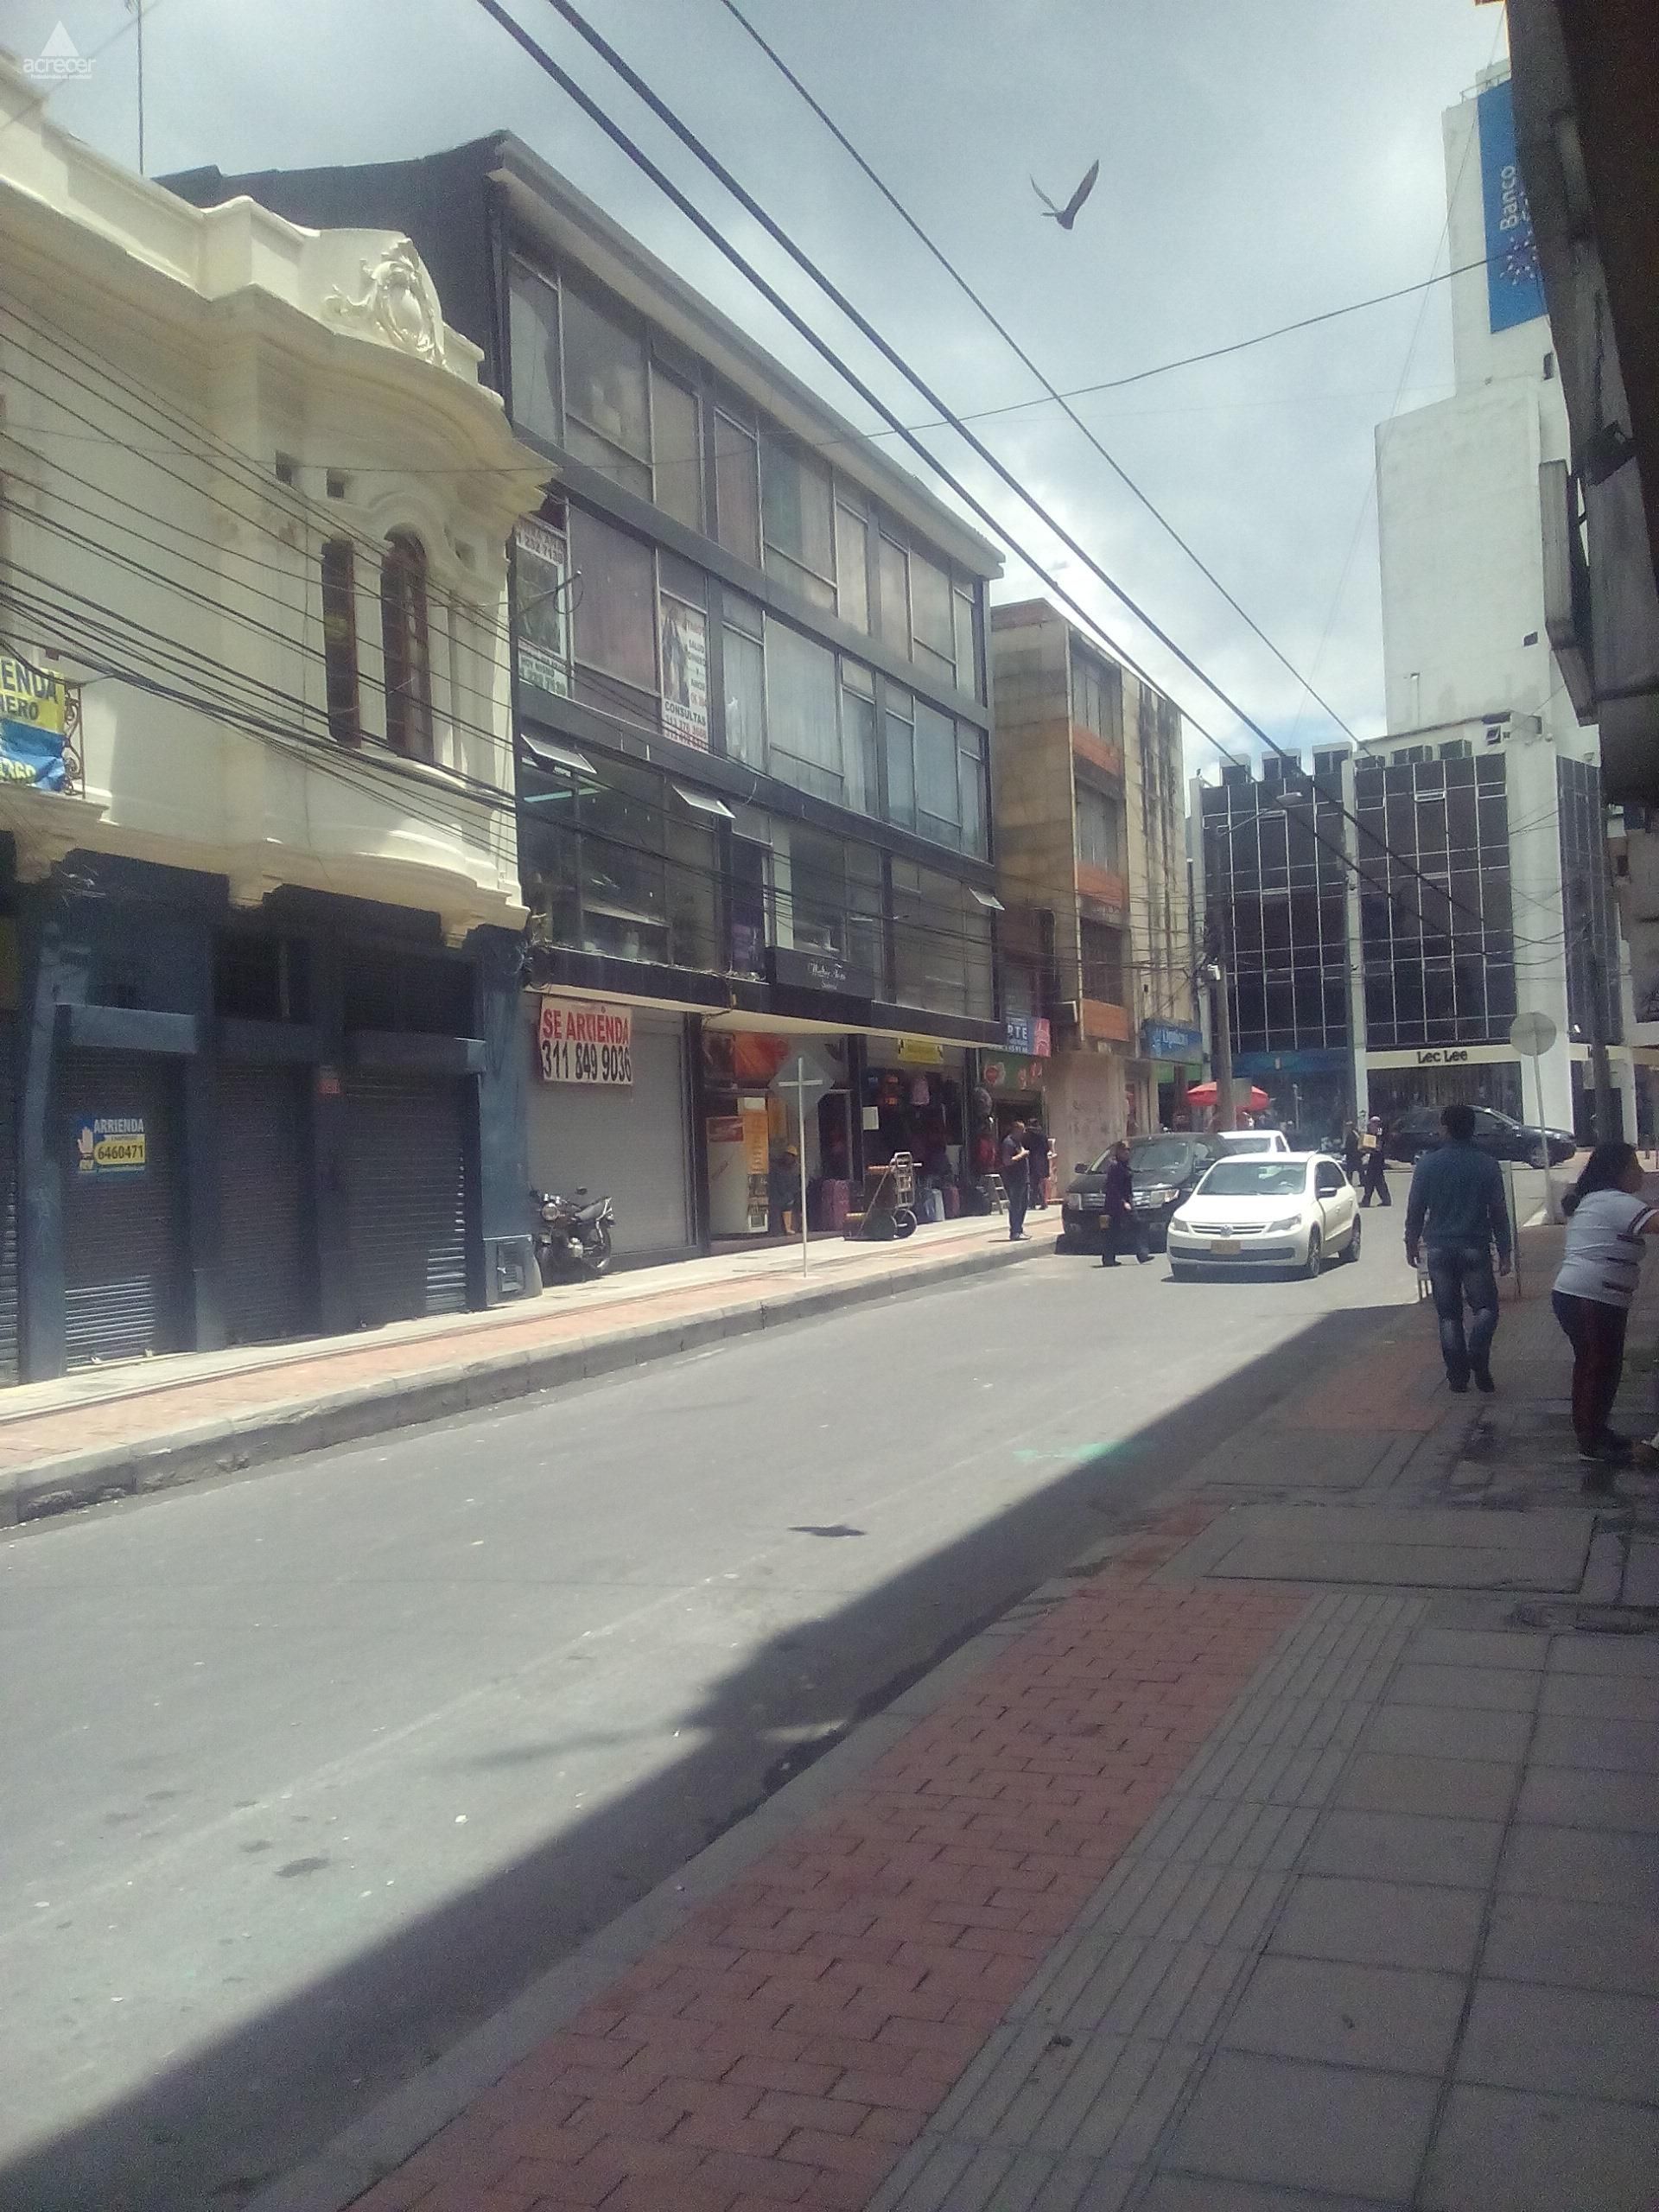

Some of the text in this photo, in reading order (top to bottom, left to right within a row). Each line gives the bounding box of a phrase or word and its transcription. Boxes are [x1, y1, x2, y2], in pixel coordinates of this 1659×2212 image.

[1500, 165, 1517, 231] Banco
[664, 701, 706, 726] CONSULTAS
[543, 1008, 562, 1039] SE
[543, 1039, 631, 1082] 311 849 9036
[1417, 1050, 1467, 1064] Lec Lee
[94, 1118, 144, 1134] ARRIENDA
[97, 1145, 143, 1160] 6460471
